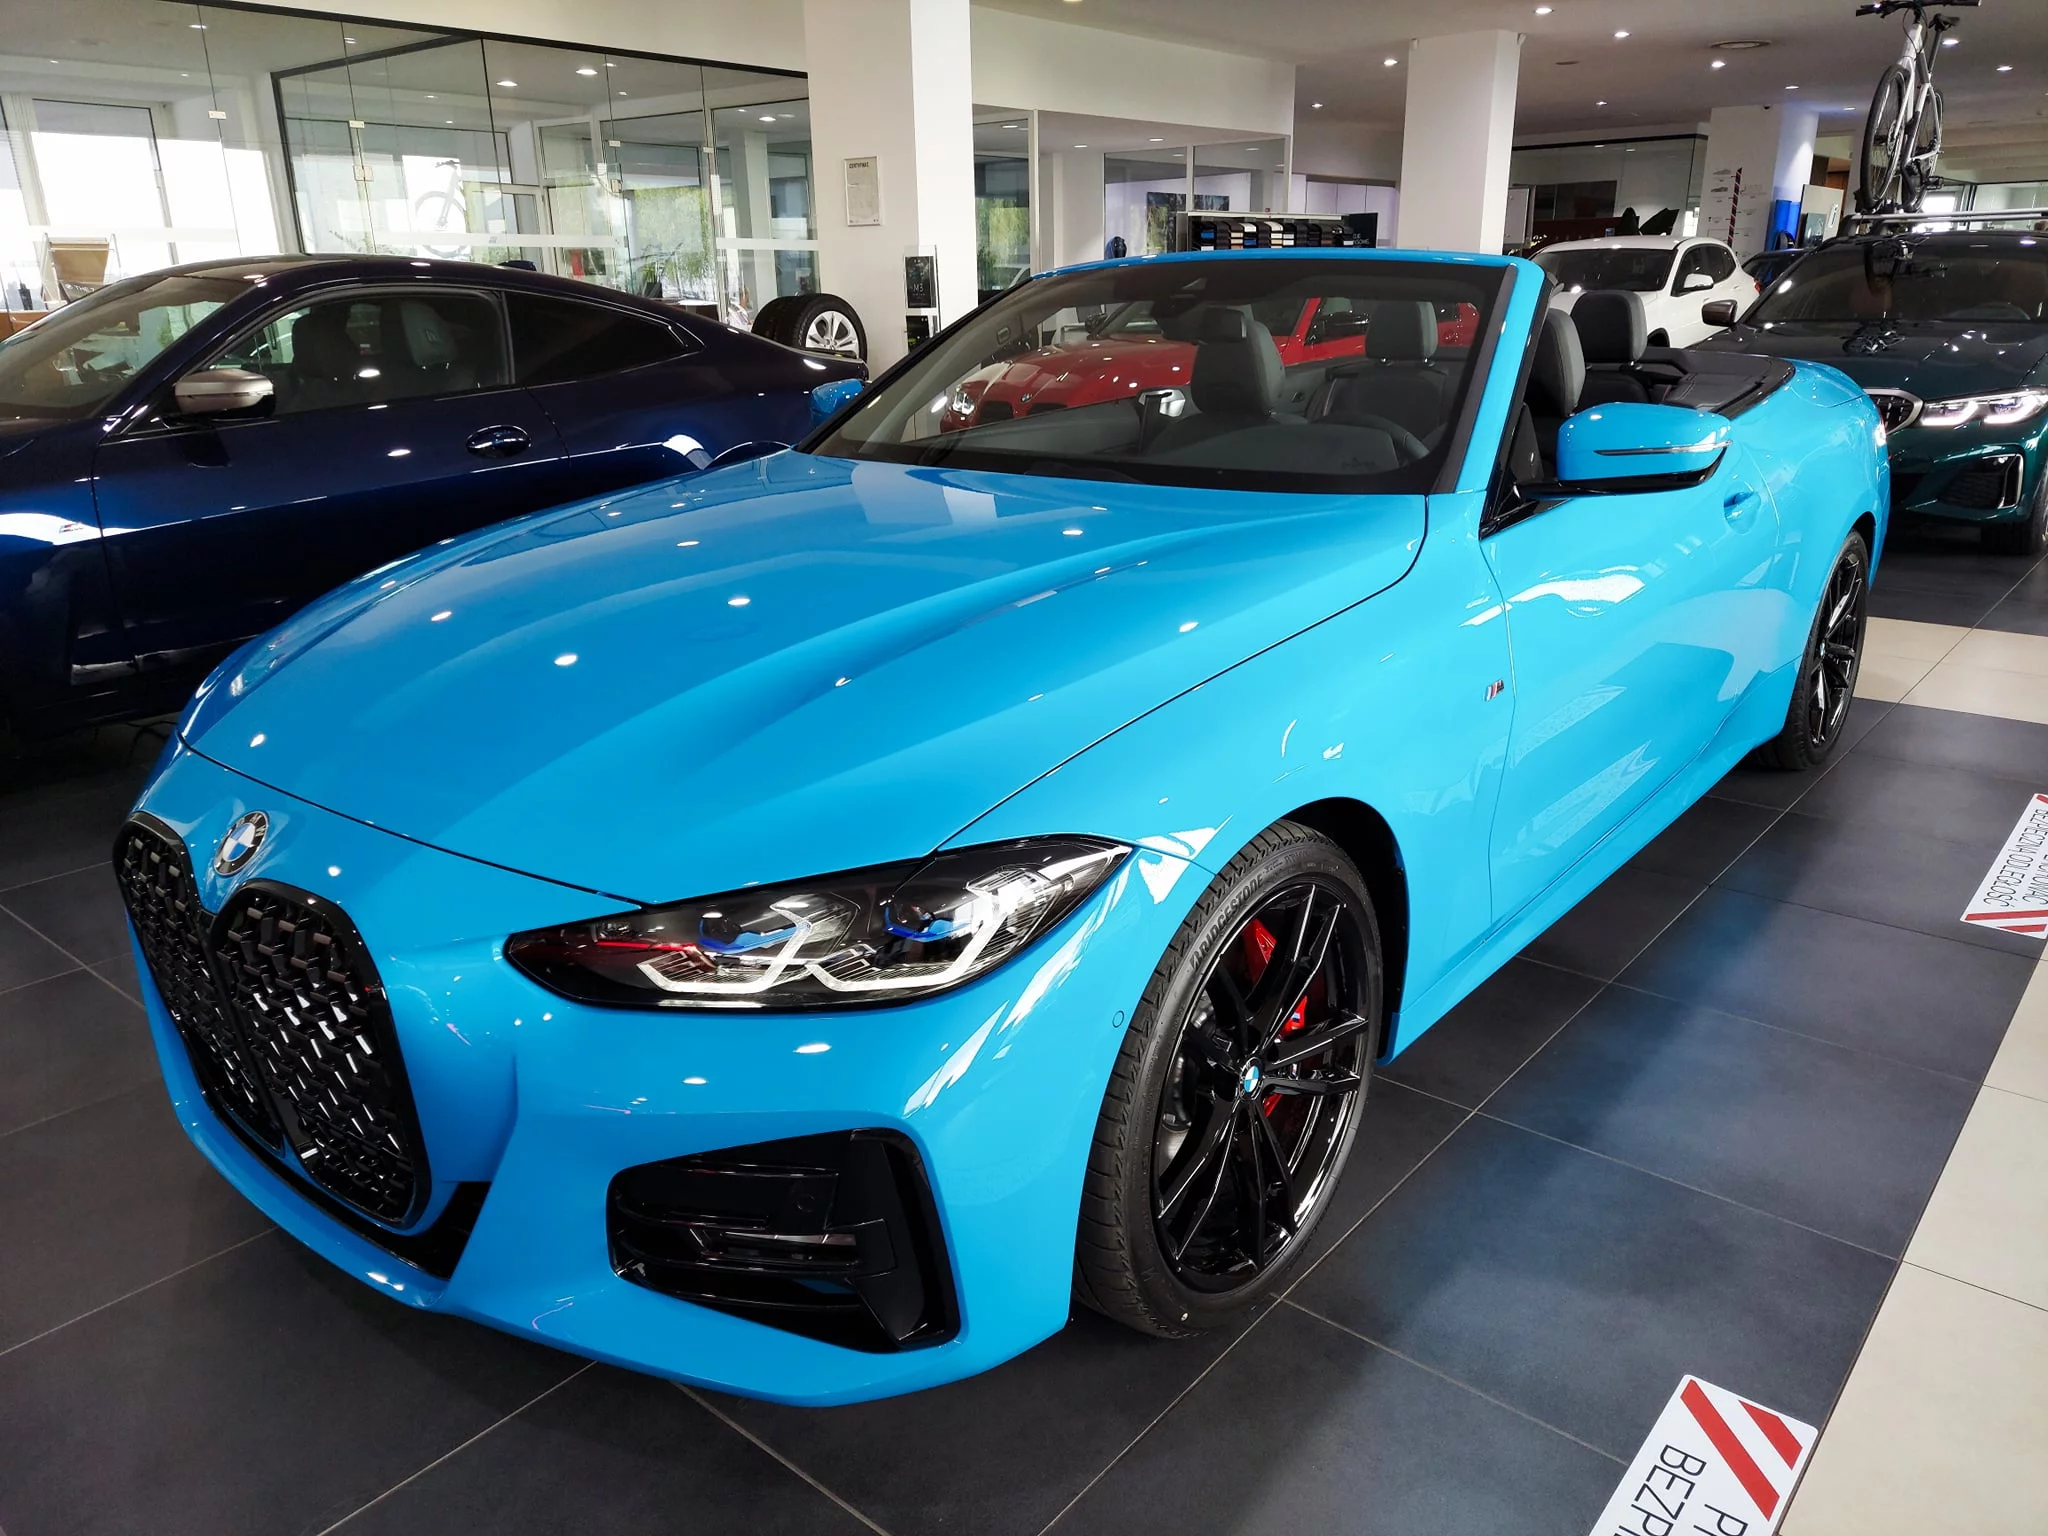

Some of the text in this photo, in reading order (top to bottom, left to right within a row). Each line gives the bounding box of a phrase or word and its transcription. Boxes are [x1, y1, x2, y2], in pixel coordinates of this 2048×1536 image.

[913, 283, 924, 292] M3
[1983, 852, 2034, 908] ODLEGŁOŚĆ
[1190, 875, 1264, 970] BRIDGESTONE
